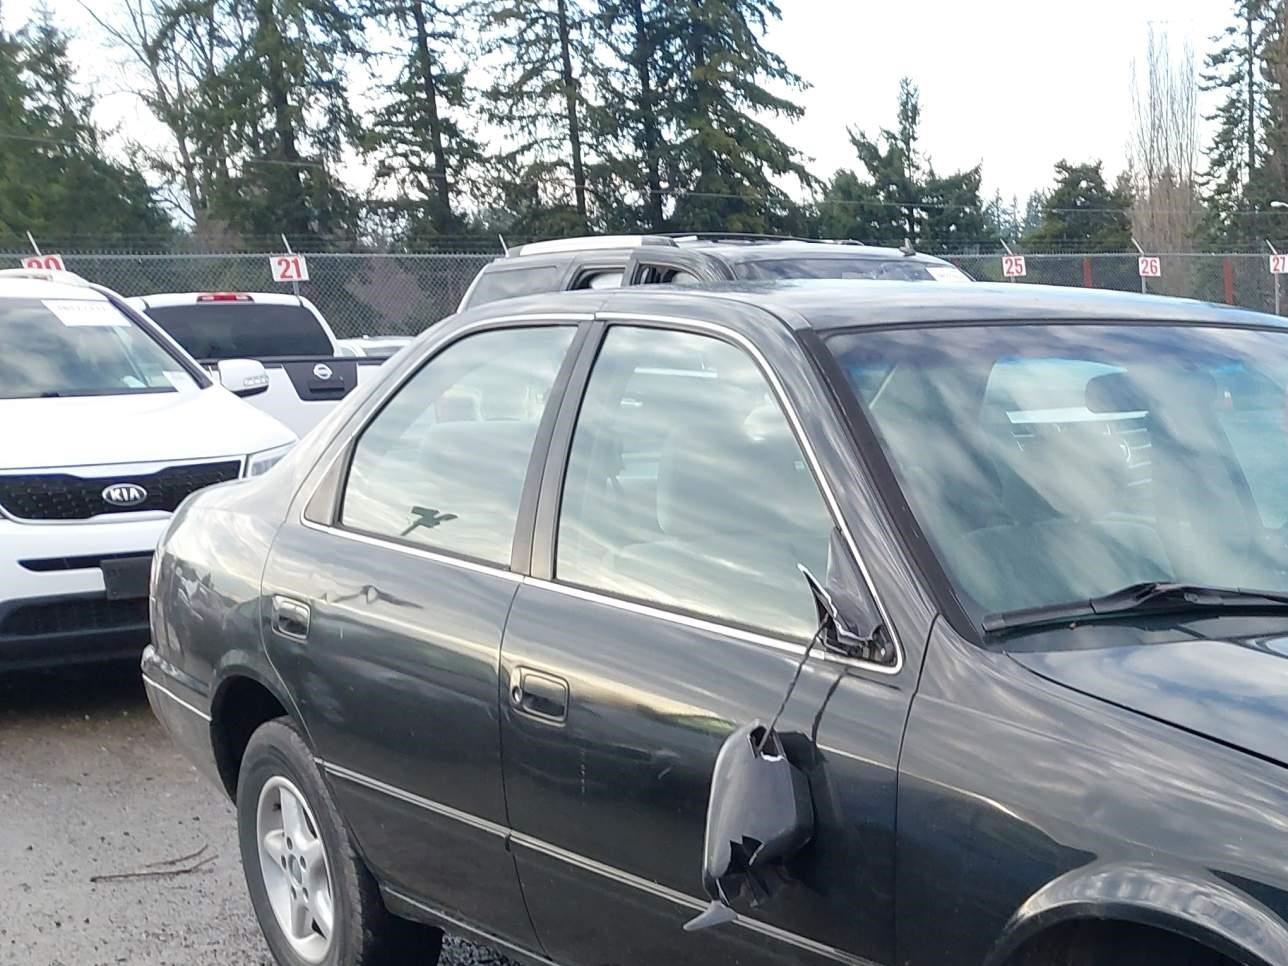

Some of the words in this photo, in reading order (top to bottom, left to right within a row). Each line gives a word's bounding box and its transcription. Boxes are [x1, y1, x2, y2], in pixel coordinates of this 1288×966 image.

[277, 256, 302, 279] 21
[1004, 257, 1023, 275] 25
[1140, 258, 1158, 275] 26
[1272, 257, 1286, 272] 27
[108, 486, 141, 503] KIA
